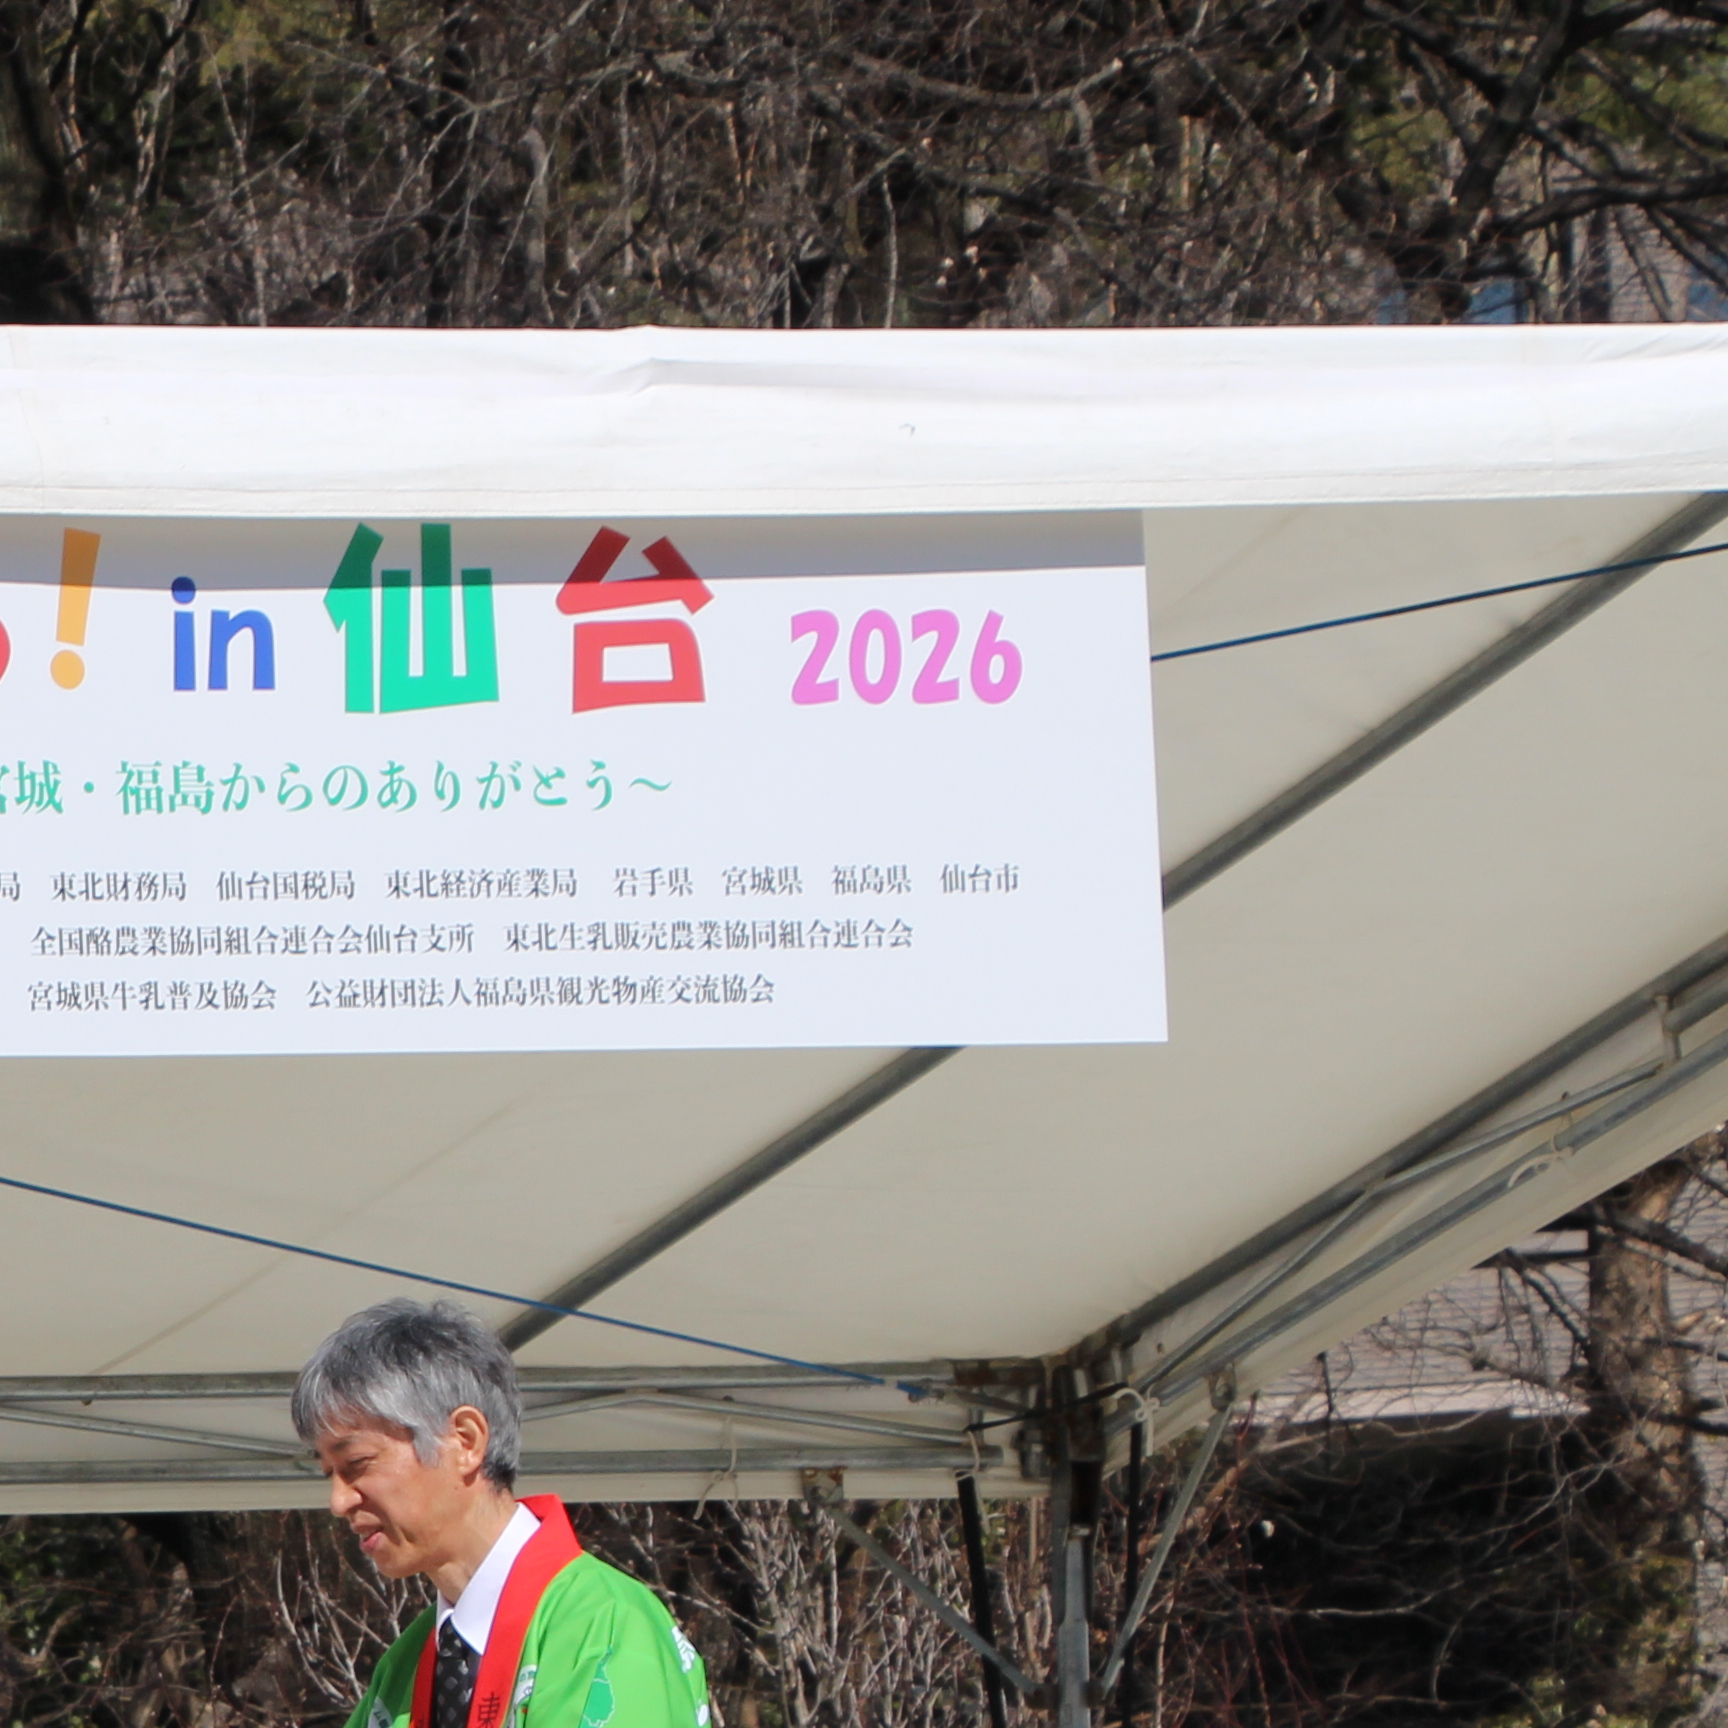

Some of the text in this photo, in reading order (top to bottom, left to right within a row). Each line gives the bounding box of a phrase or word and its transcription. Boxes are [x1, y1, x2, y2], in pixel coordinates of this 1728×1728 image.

[171, 575, 276, 692] in
[789, 609, 1023, 706] 2026
[51, 870, 188, 903] 東北財務局
[215, 869, 357, 902] 仙台国税局
[385, 867, 579, 900] 東北経済産業局
[613, 866, 695, 898] 岩手県
[721, 864, 804, 897] 宮城県
[831, 863, 913, 896] 福島県
[940, 862, 1020, 895] 仙台市
[30, 922, 475, 957] 全国酪農業協同組合連合会仙台支所
[504, 918, 915, 954] 東北生乳販売農業協同組合連合会
[26, 978, 278, 1013] 宮城県牛乳普及協会
[305, 973, 776, 1009] 公益財団法人福島県観光物産交流協会
